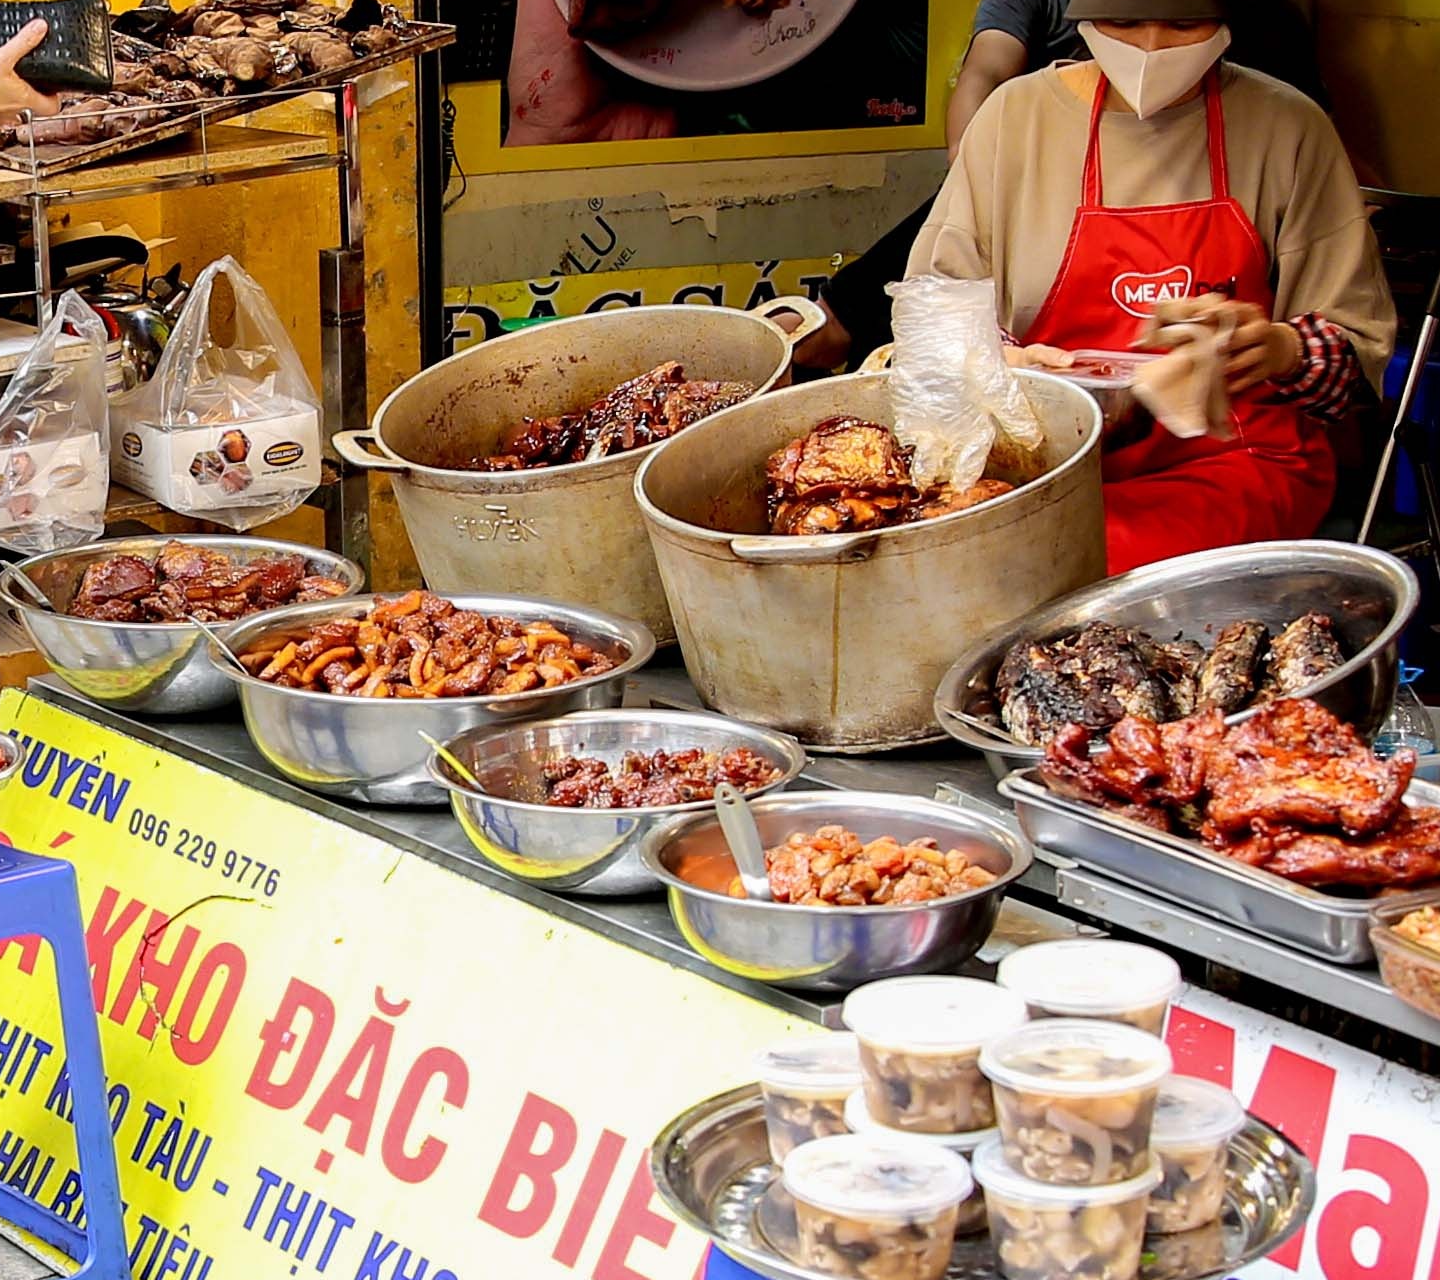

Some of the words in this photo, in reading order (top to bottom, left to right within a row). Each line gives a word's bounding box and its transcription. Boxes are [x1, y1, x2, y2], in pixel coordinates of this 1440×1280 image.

[128, 807, 168, 849] 096
[172, 828, 214, 871] 229
[221, 849, 282, 898] 9776
[84, 883, 249, 1066] KHO
[244, 976, 471, 1185] ĐẶC
[129, 1090, 214, 1193] TÀU
[242, 1167, 356, 1275] THỊT
